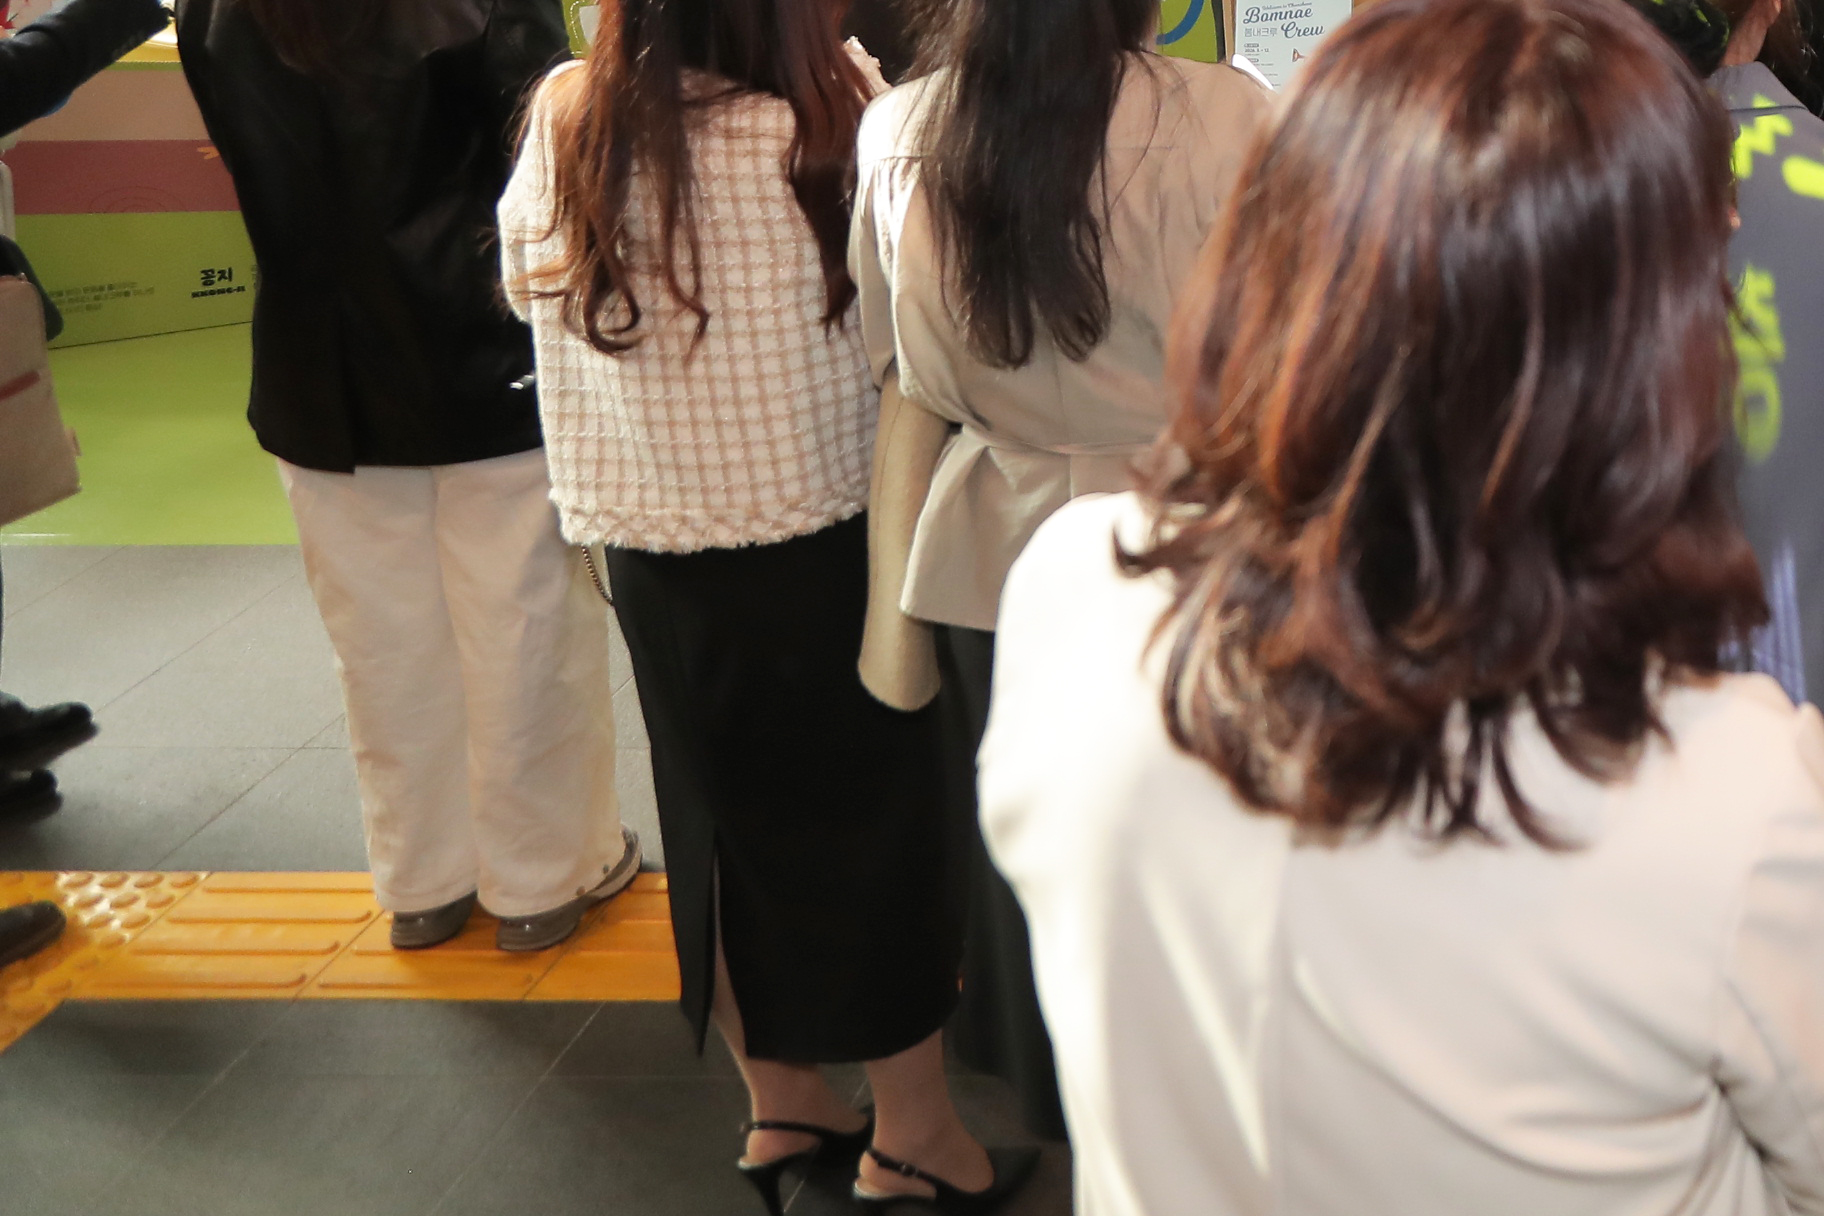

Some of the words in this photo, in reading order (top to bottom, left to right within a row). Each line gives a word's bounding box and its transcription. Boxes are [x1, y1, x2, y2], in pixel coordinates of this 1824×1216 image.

[1243, 6, 1313, 24] Bomnae
[1244, 27, 1278, 37] 봄내크루
[1280, 21, 1325, 39] Crew
[200, 267, 233, 286] 꽁지
